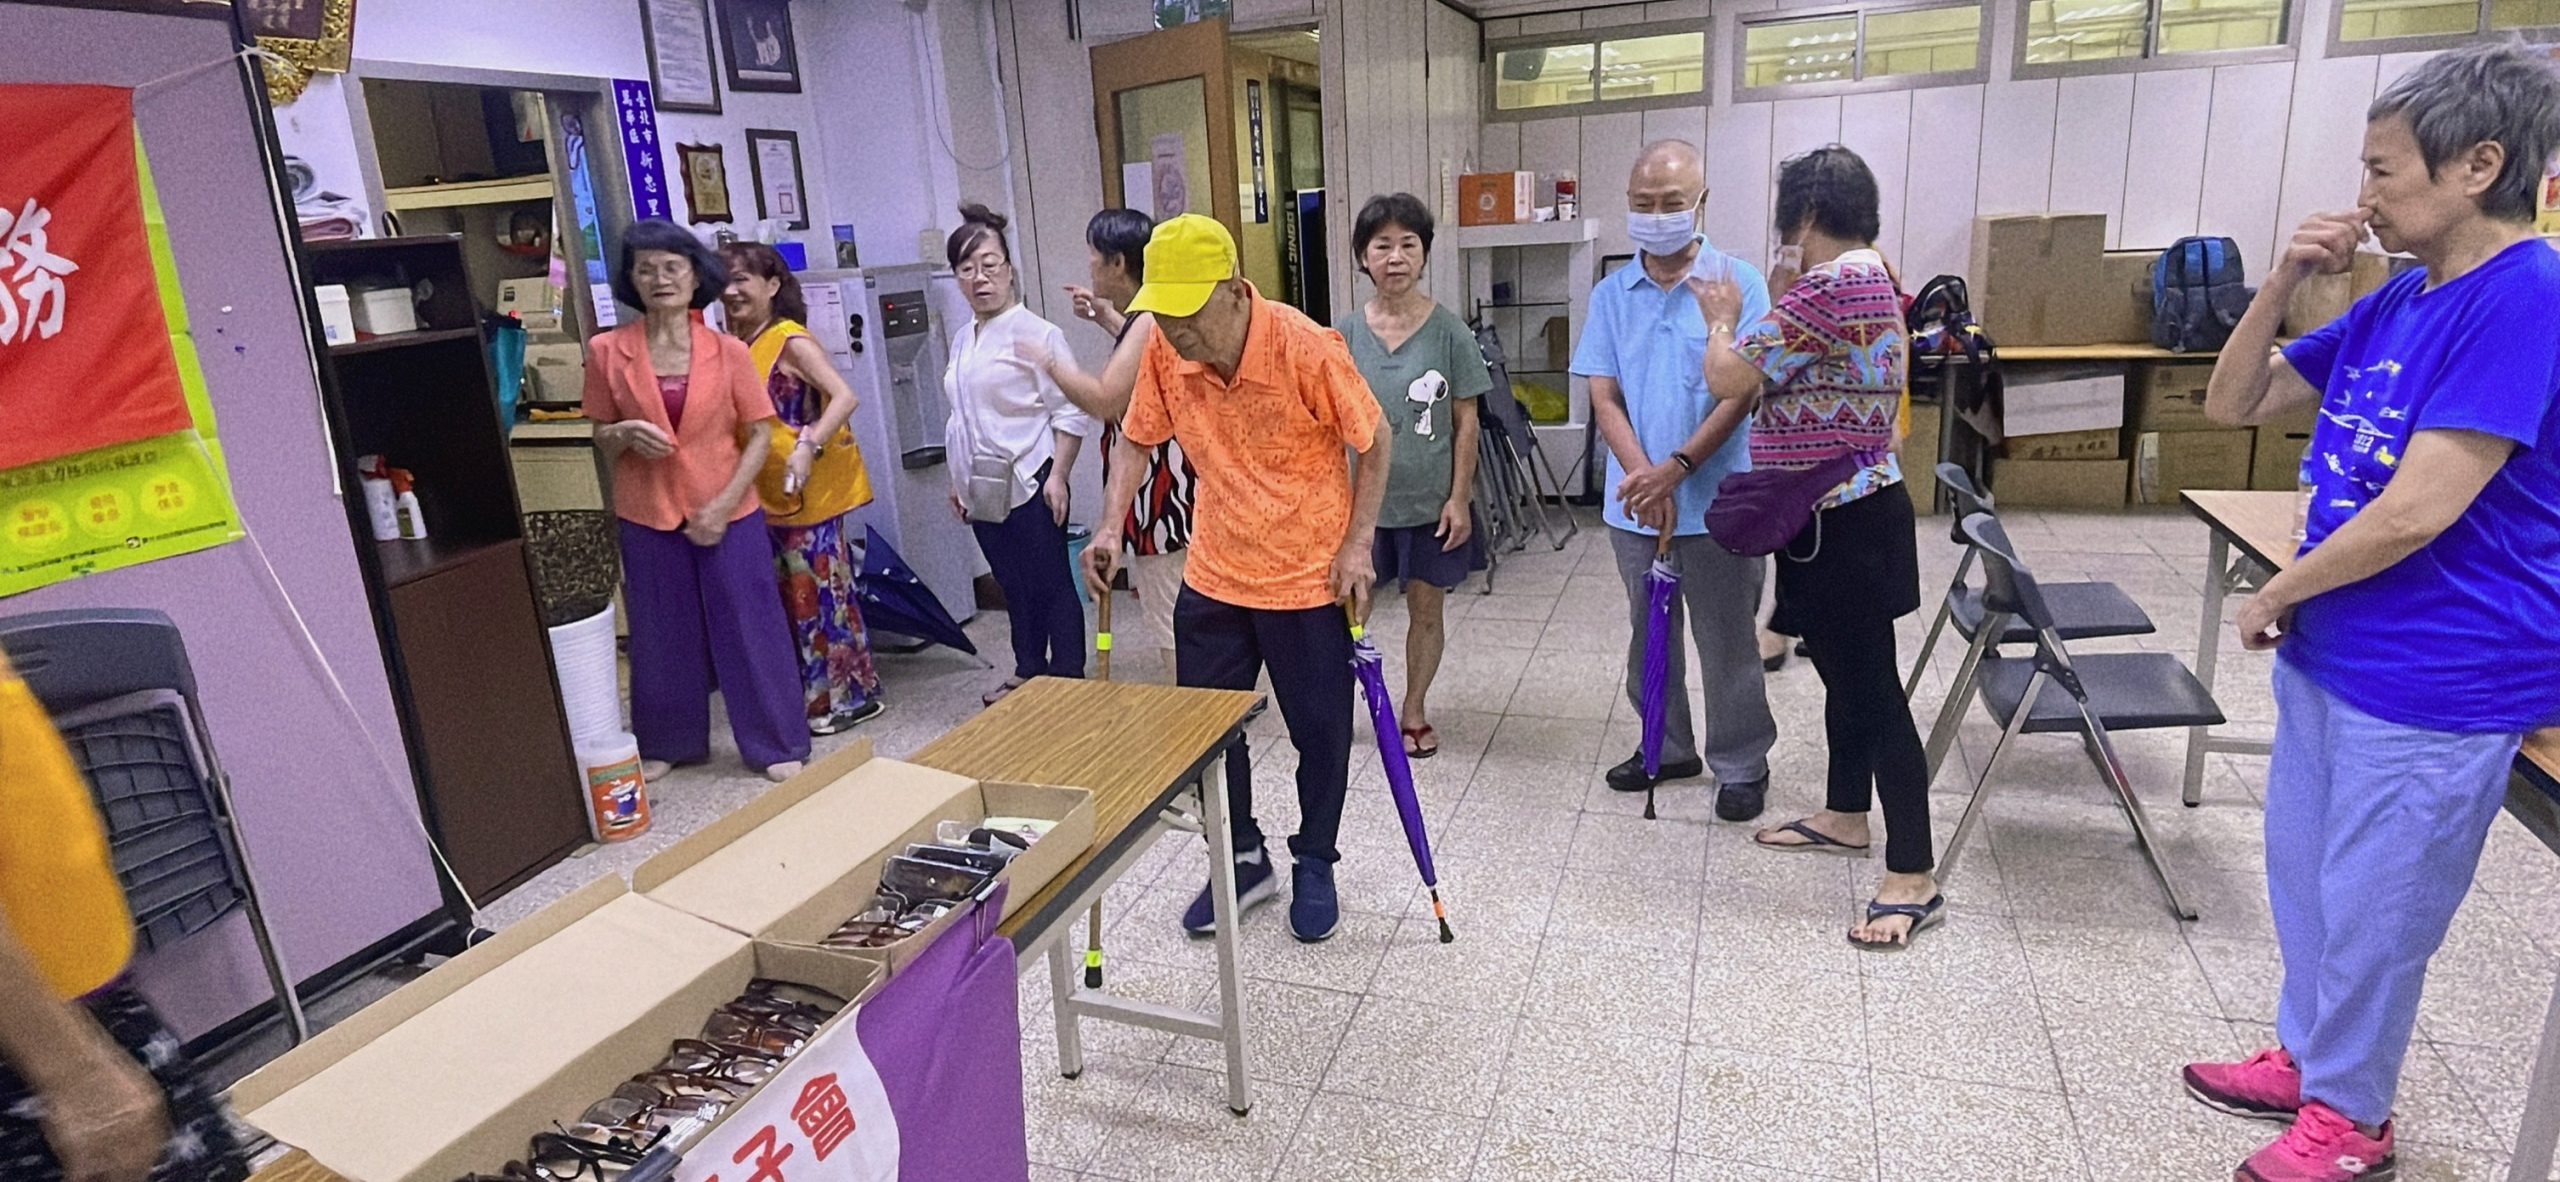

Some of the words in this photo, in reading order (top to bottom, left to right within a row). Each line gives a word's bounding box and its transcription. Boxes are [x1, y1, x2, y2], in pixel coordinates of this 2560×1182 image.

[636, 89, 652, 145] 臺北市
[640, 149, 660, 216] 新忠里
[0, 197, 80, 346] 務
[704, 1072, 856, 1182] 子會
